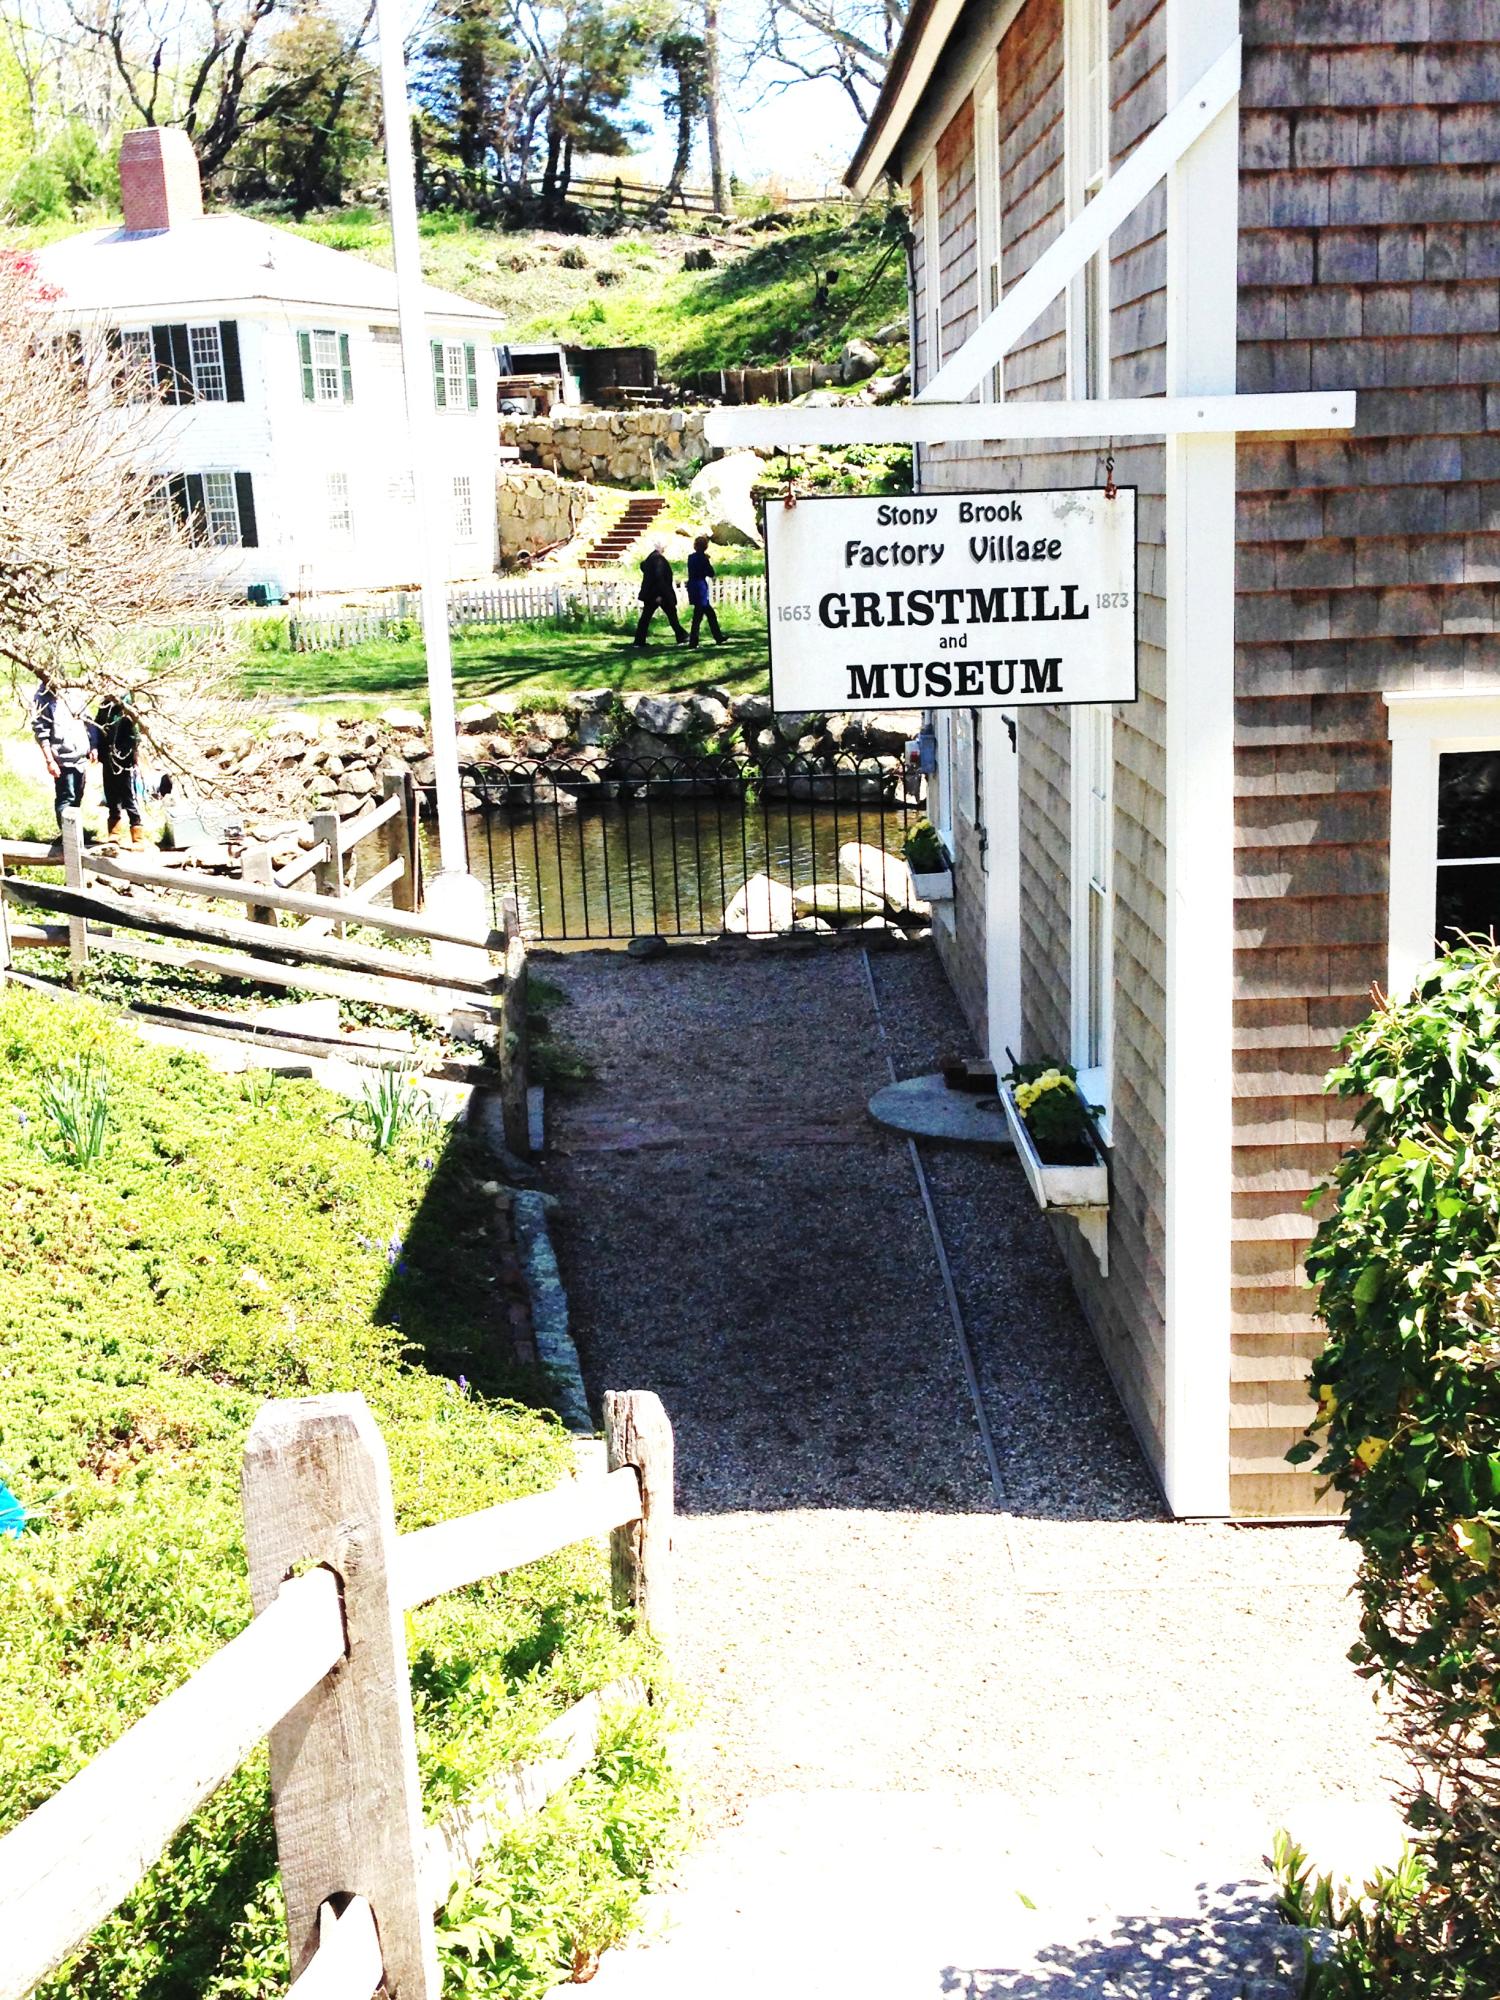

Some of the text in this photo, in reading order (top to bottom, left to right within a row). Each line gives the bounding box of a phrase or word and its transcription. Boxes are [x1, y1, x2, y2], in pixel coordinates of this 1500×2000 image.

[877, 500, 1023, 526] Stony Brook
[845, 536, 1062, 568] Factory Village
[777, 605, 811, 622] 1663
[818, 584, 1090, 629] GRISTMILL
[1095, 592, 1130, 610] 1873
[939, 633, 968, 649] and
[846, 657, 1064, 700] MUSEUM
